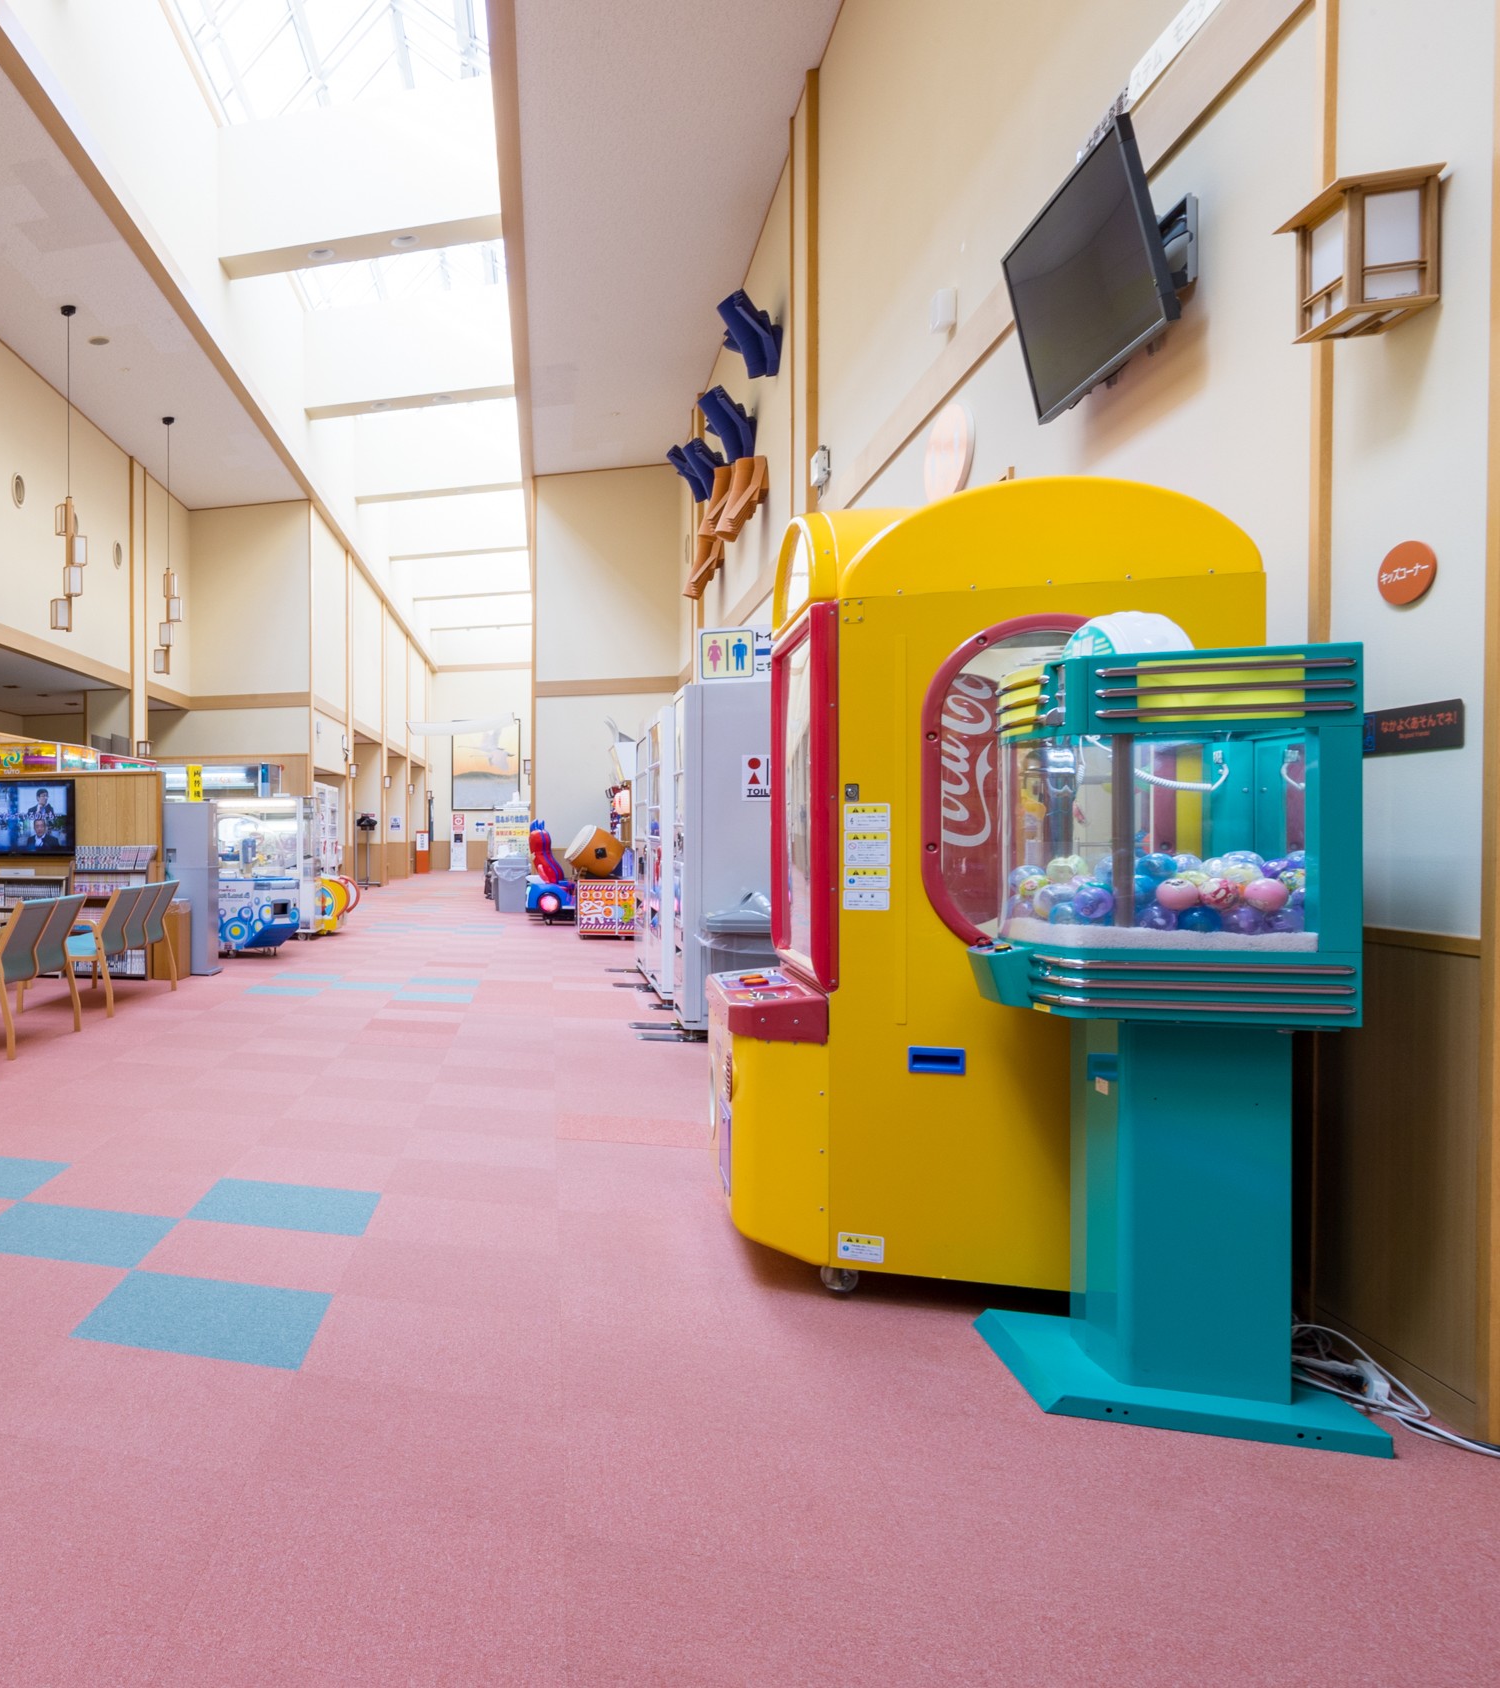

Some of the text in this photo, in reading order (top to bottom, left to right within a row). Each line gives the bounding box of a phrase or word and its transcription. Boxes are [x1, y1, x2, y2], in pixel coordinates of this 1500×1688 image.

[1380, 563, 1429, 584] キッズコーナー
[755, 631, 772, 642] トイ
[756, 661, 772, 672] こち
